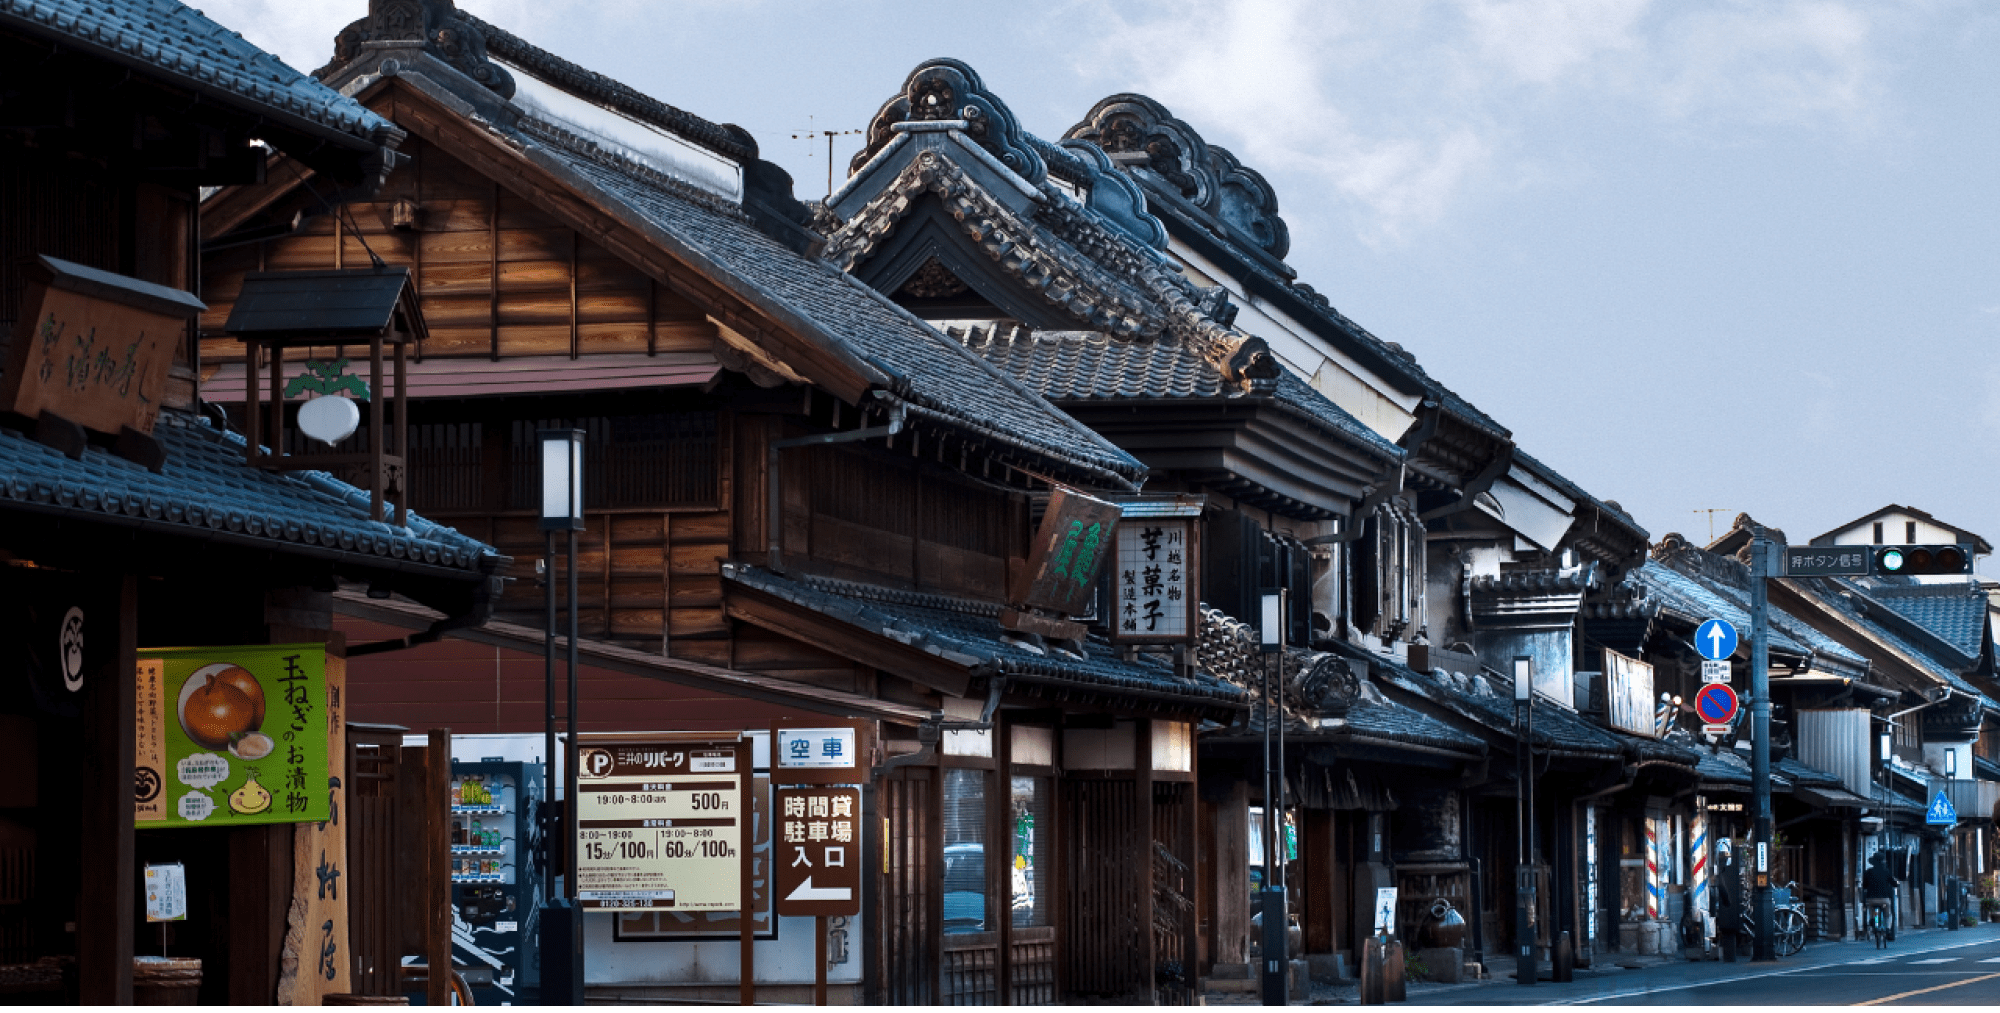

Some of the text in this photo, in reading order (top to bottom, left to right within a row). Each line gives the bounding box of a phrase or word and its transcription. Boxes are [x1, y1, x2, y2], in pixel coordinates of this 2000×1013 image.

[1167, 530, 1182, 601] 川越名物
[1791, 553, 1862, 568] 押ボタン信号
[1140, 527, 1164, 631] 芋菓子
[277, 654, 313, 815] 玉ねぎのお漬物
[618, 751, 684, 768] 三井のリパーク
[790, 737, 843, 760] 空車
[593, 754, 609, 774] P
[691, 792, 729, 811] 500円
[784, 795, 852, 819] 時間貸
[784, 819, 852, 844] 駐車場
[791, 846, 845, 868] 入口
